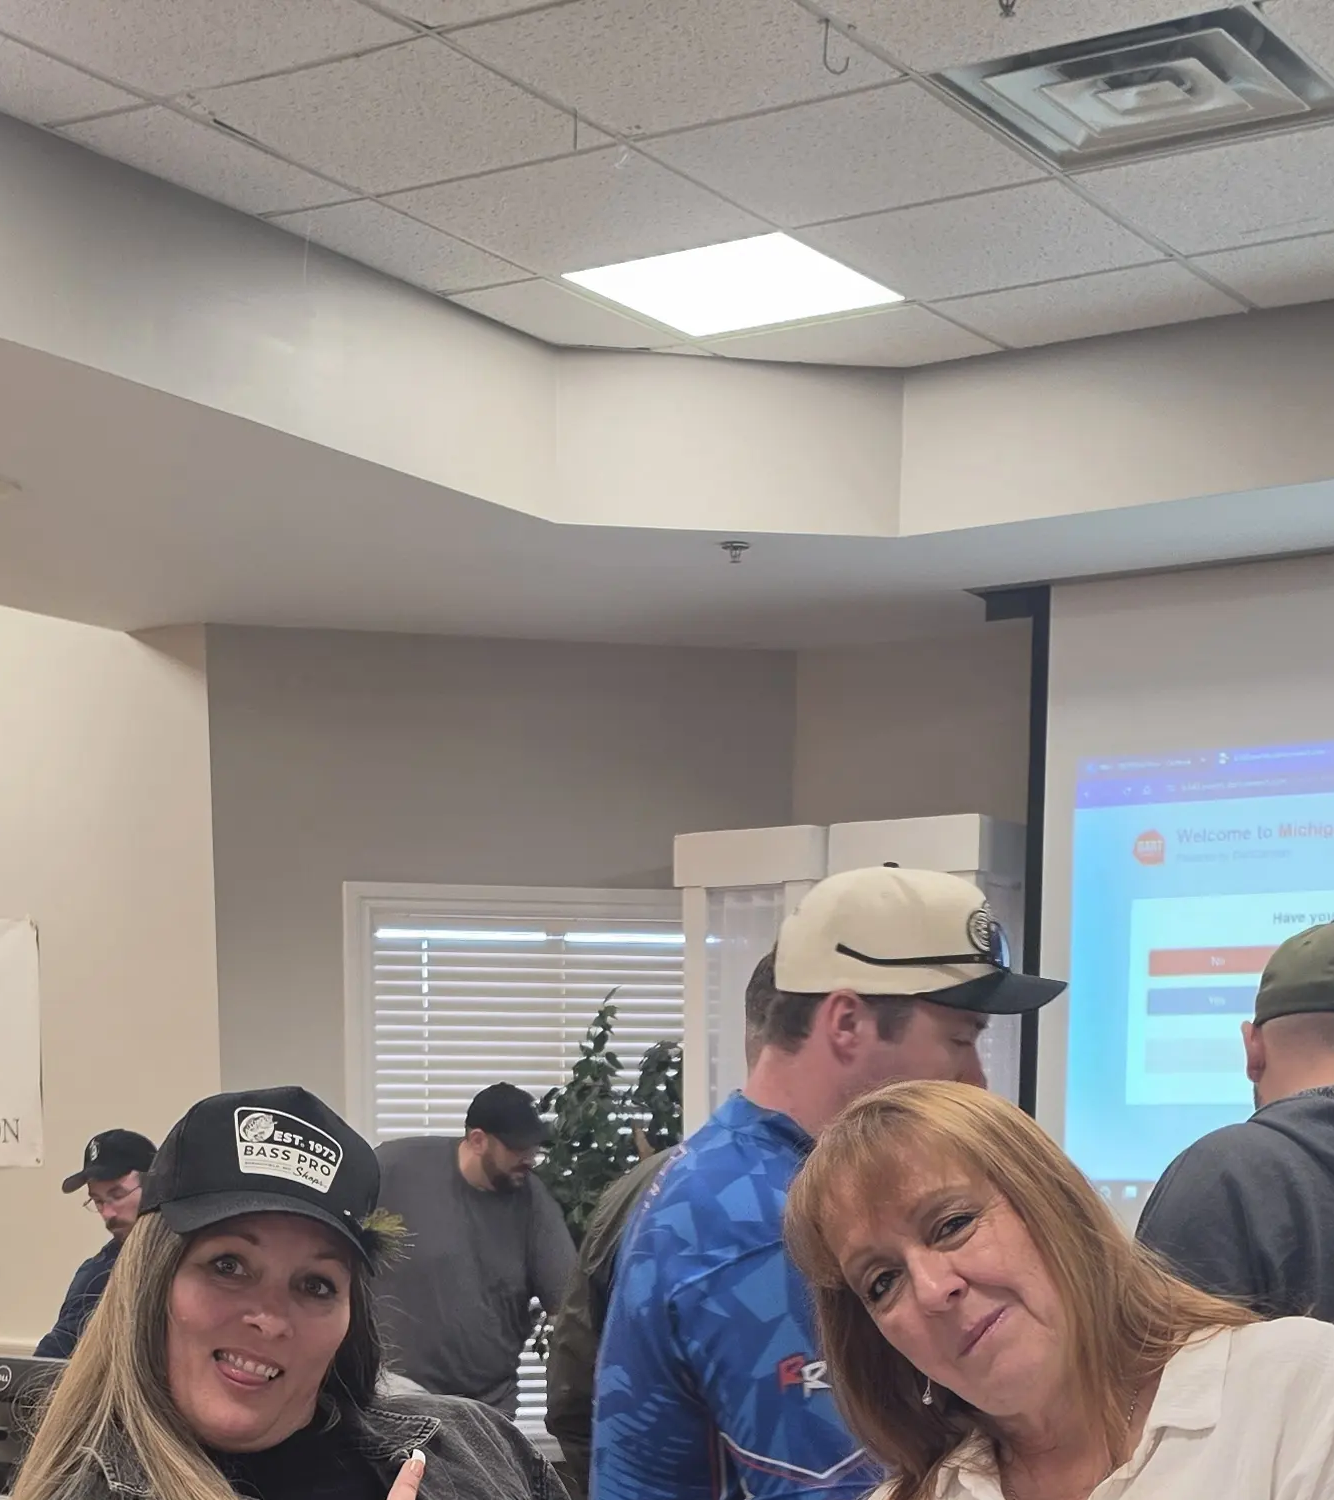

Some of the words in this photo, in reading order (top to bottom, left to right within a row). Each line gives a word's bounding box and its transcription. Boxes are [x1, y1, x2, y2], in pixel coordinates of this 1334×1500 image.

[1176, 828, 1251, 844] Welcome
[1257, 825, 1273, 840] to
[1273, 912, 1306, 925] Have
[1310, 912, 1334, 926] you
[244, 1145, 291, 1161] BASS
[297, 1154, 331, 1177] PRO
[309, 1140, 337, 1163] 1972
[293, 1166, 324, 1187] Shops
